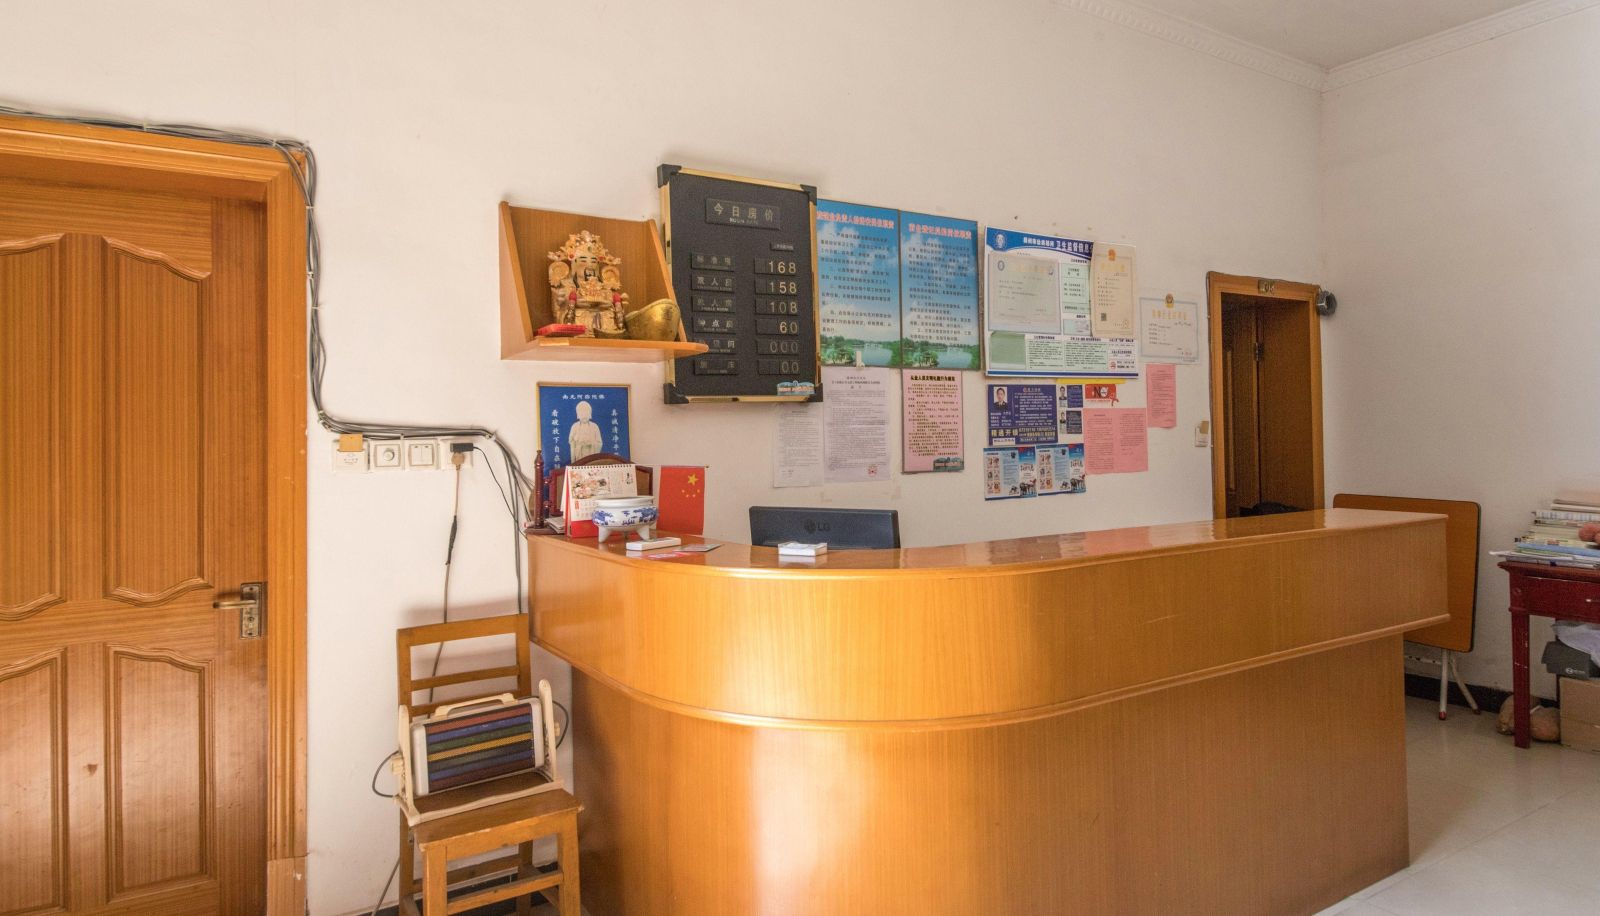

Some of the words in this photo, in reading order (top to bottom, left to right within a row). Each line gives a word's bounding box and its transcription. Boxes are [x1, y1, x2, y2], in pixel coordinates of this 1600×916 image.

[713, 203, 774, 222] 今日房价
[768, 260, 797, 274] 168
[769, 281, 797, 295] 158
[770, 301, 798, 314] 108
[779, 321, 798, 335] 60
[817, 520, 831, 531] LG
